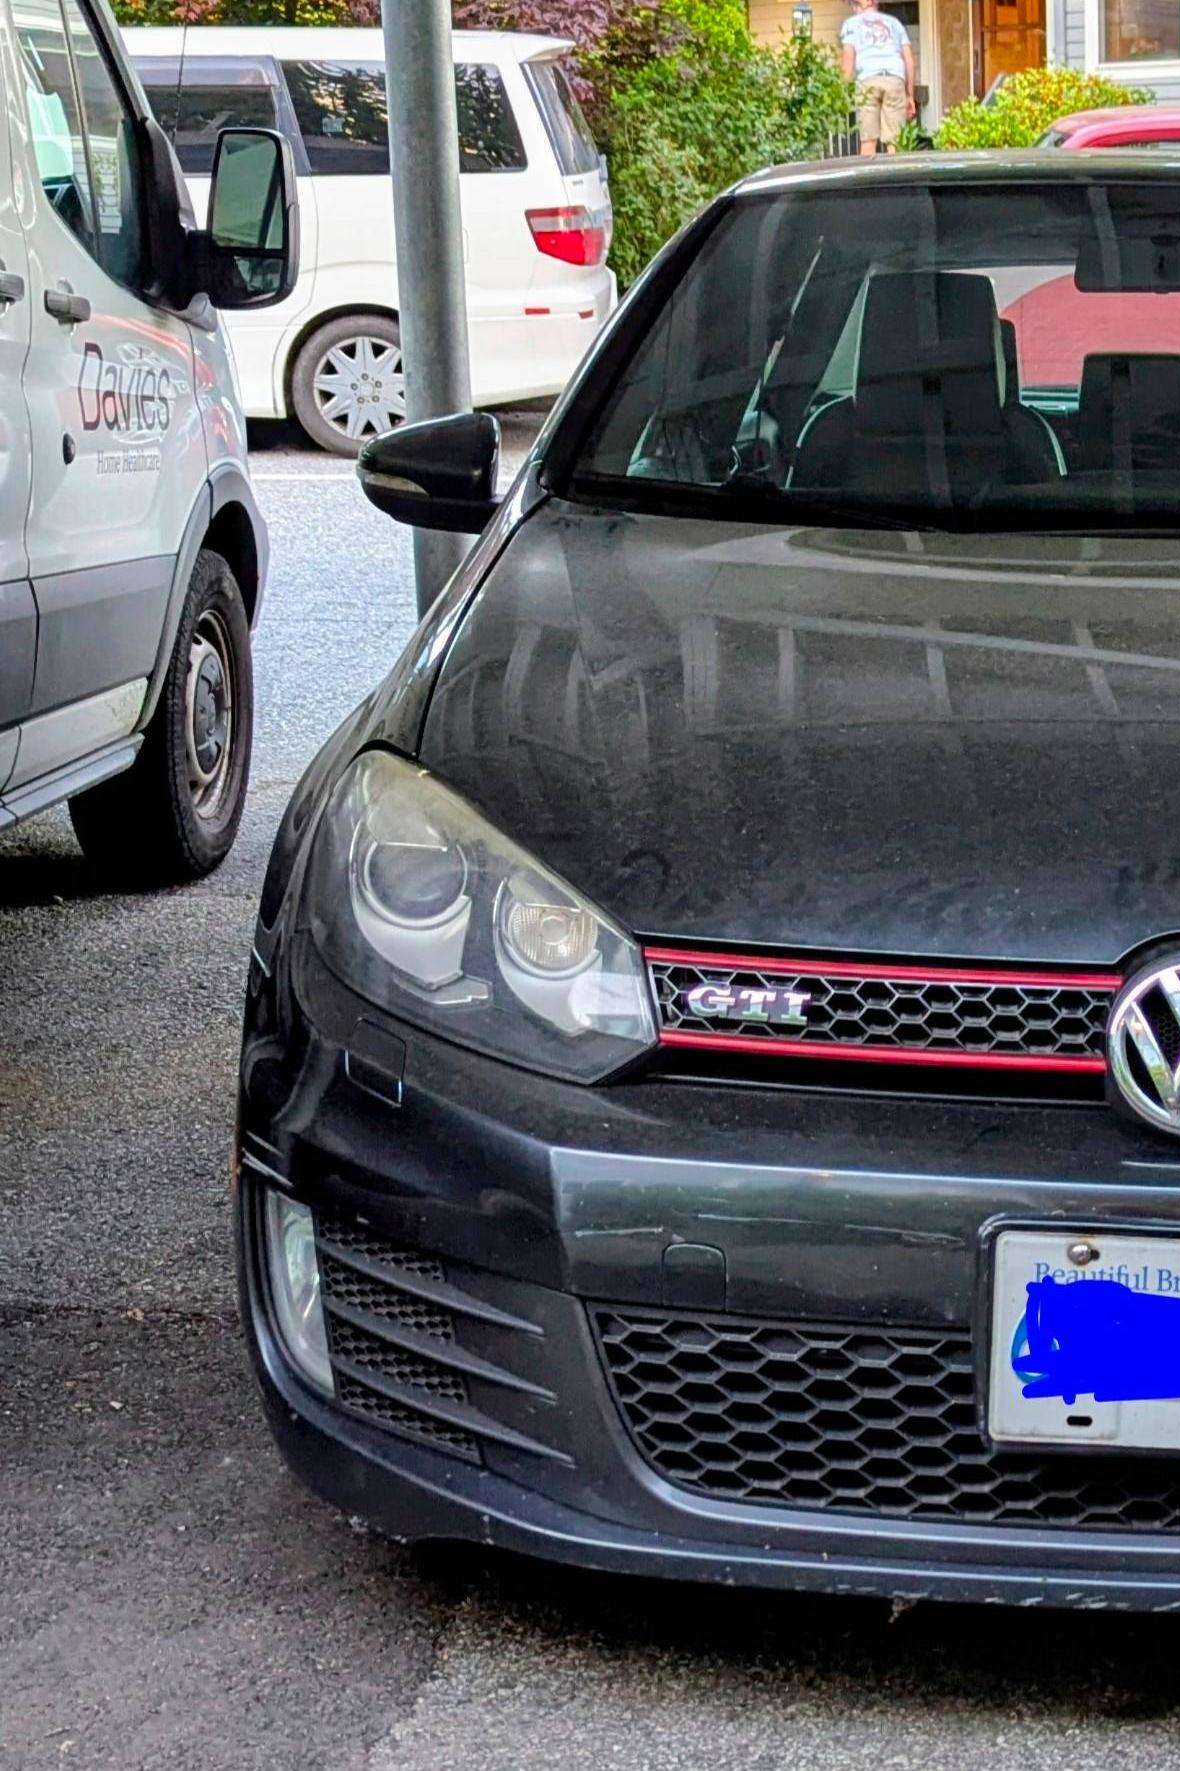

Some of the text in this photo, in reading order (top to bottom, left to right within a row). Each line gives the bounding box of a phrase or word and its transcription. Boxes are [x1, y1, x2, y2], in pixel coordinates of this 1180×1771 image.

[78, 342, 170, 432] Davies
[96, 449, 121, 475] Home
[687, 986, 812, 1025] GTI
